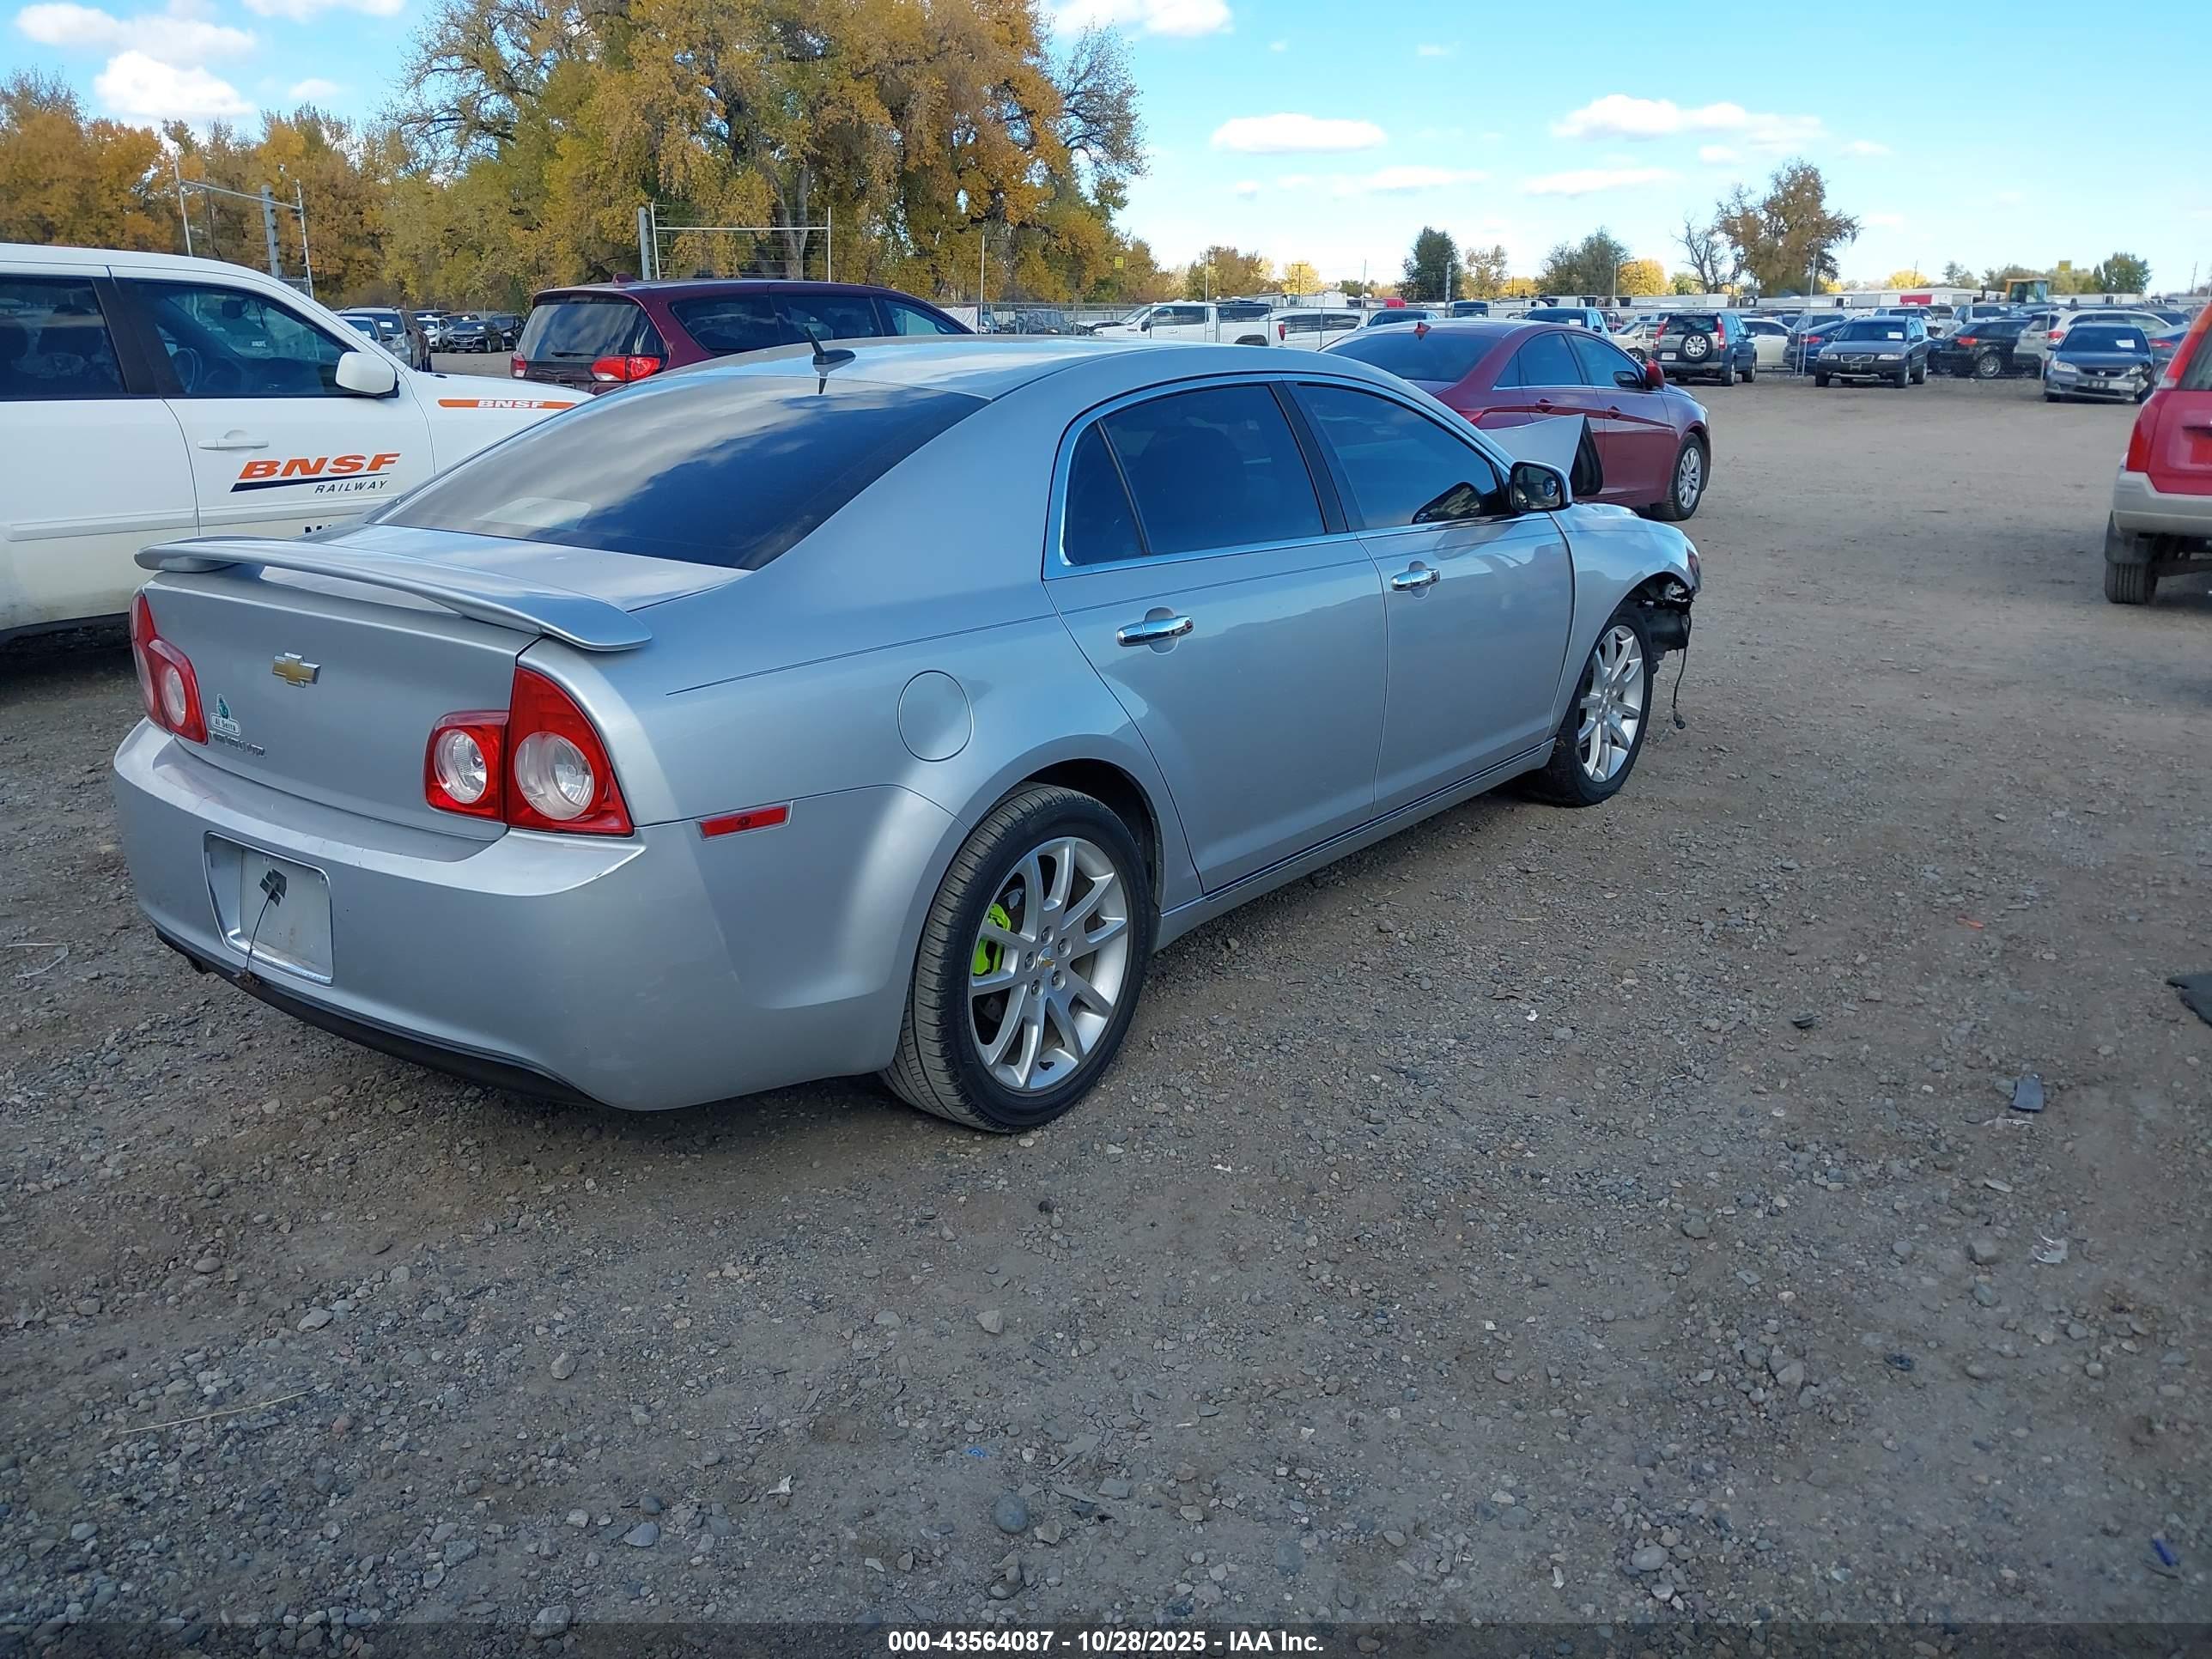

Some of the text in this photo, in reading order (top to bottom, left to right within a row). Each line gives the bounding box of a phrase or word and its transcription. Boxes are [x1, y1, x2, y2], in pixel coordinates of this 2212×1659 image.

[477, 399, 545, 409] BNSF
[238, 453, 402, 480] BNSF
[314, 480, 388, 494] RAILWAY
